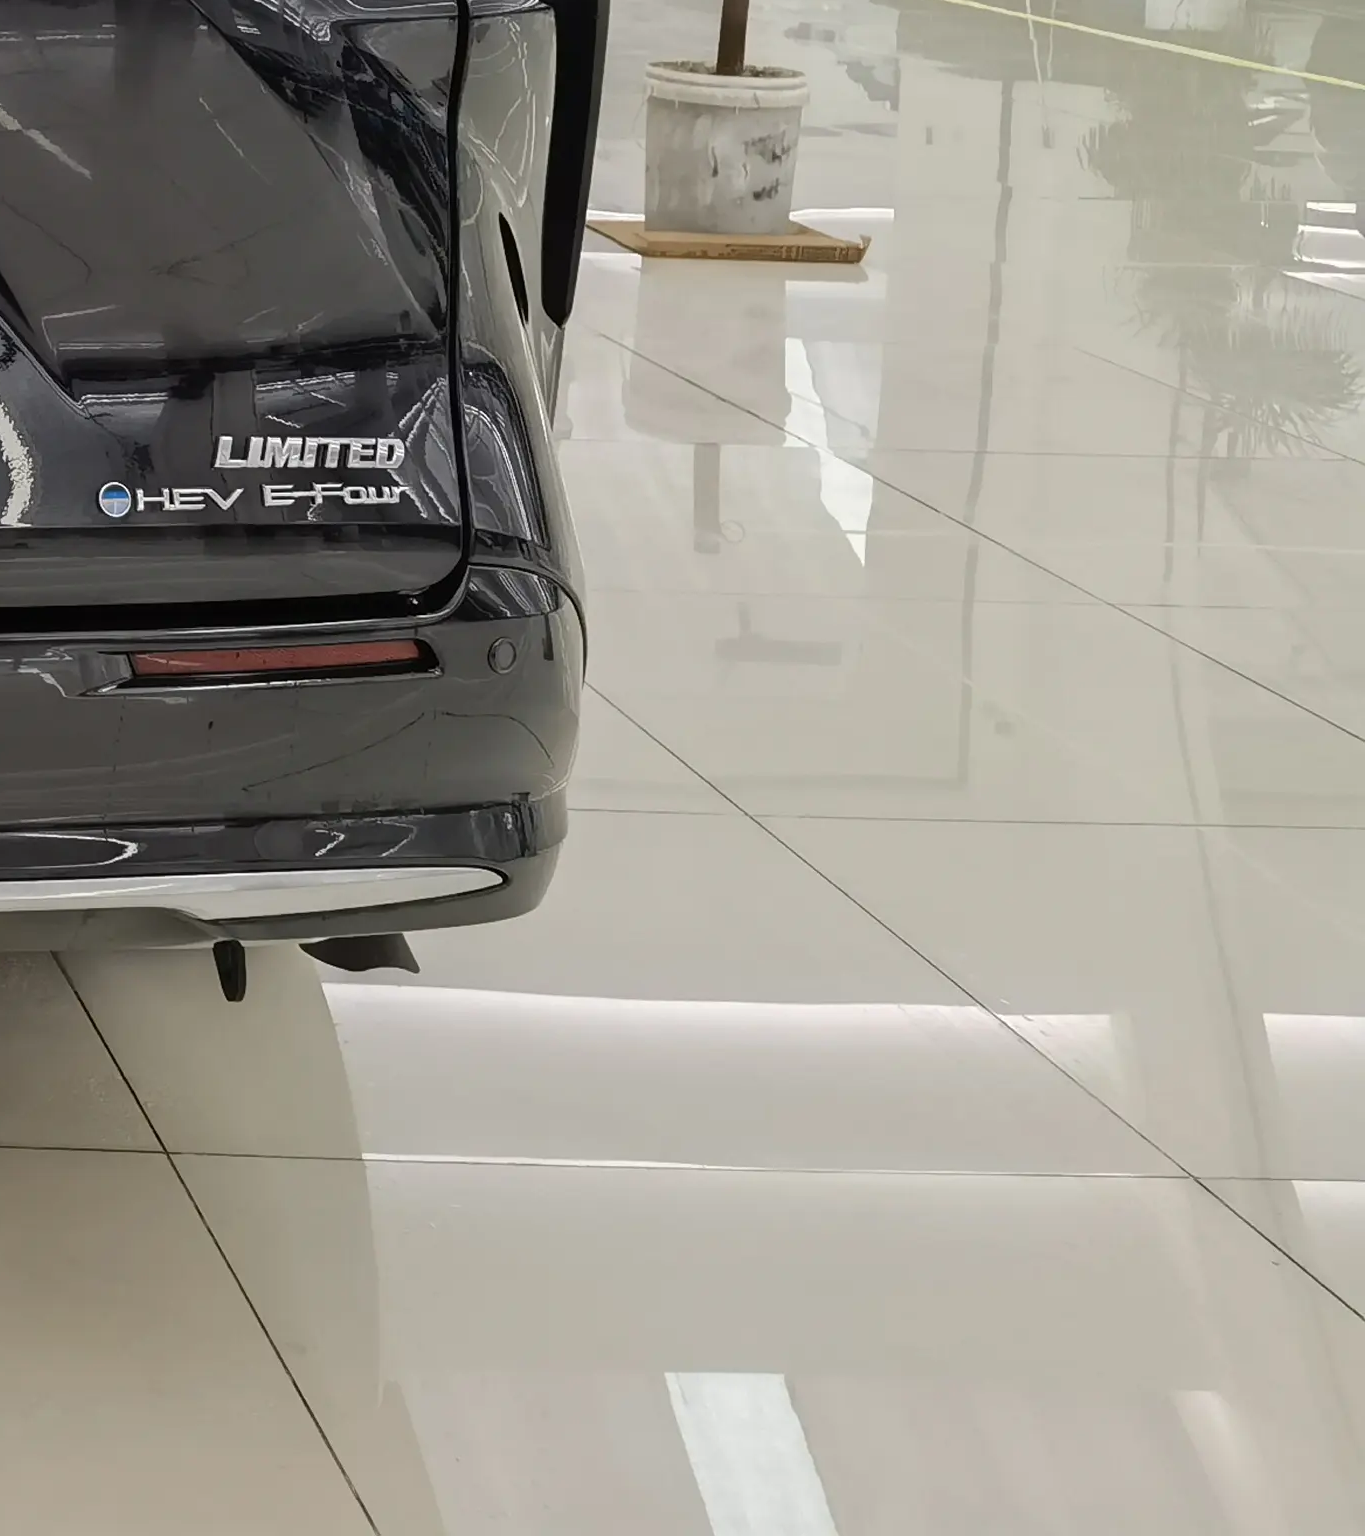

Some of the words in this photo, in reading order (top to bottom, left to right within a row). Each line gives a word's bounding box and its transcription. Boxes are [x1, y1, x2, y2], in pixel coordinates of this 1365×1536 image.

[213, 436, 405, 469] LIMITED
[135, 487, 244, 511] HEV
[262, 482, 411, 507] E-Four
